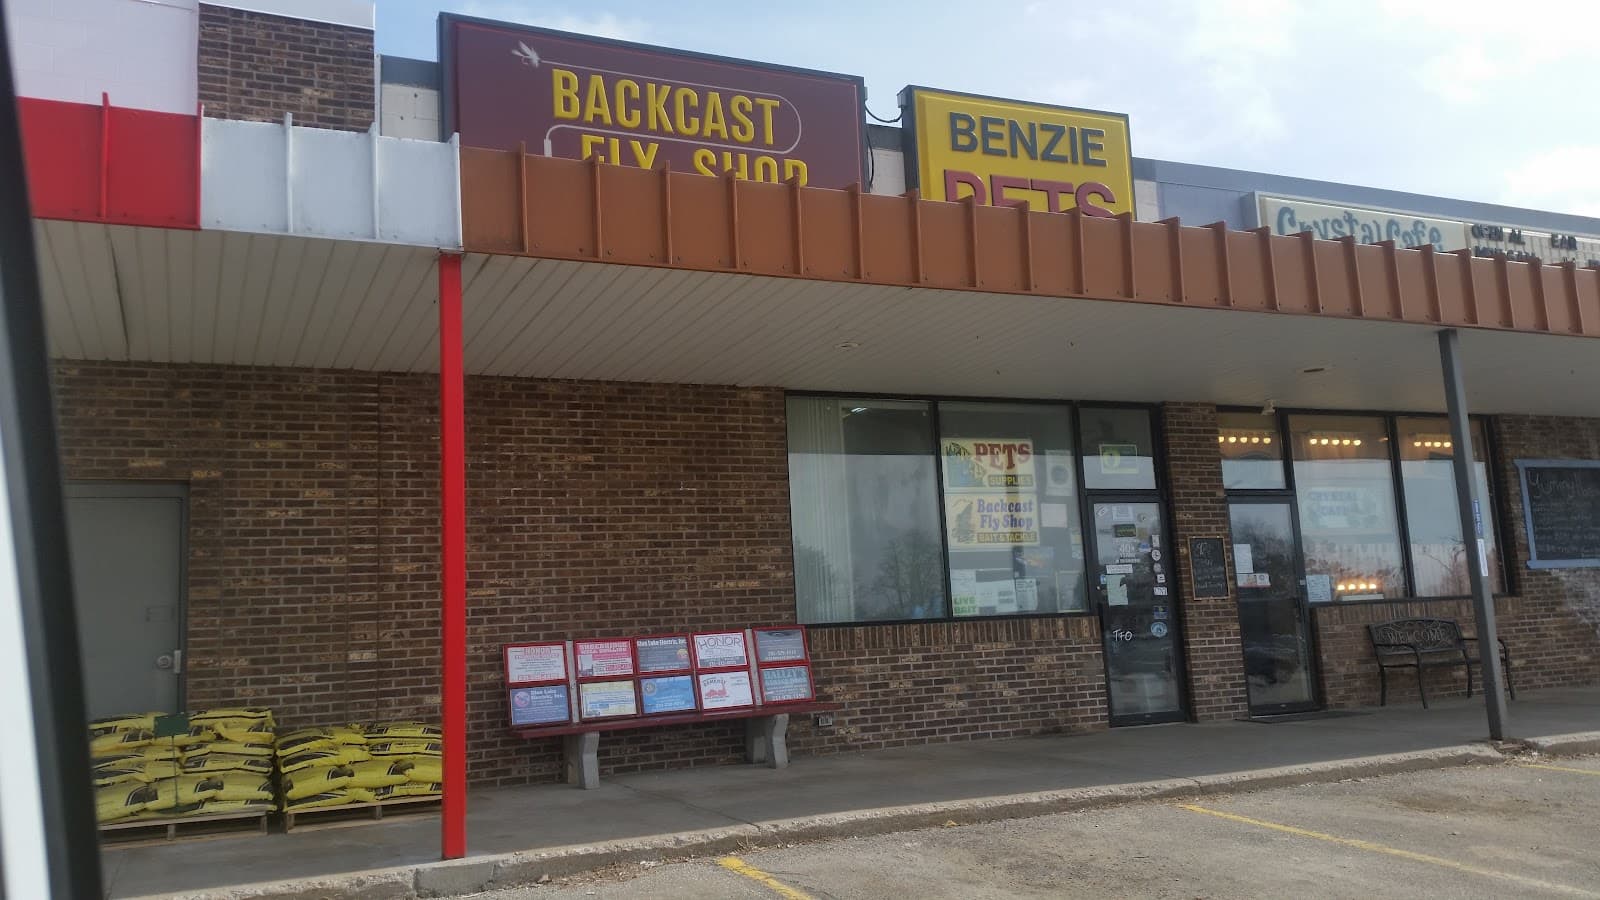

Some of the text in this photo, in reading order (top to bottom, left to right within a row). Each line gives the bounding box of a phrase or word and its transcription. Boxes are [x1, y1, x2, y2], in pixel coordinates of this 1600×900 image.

[552, 69, 780, 145] BACKCAST
[949, 111, 1108, 167] BENZIE
[974, 443, 1031, 470] PETS
[977, 499, 1032, 513] Backcast
[980, 514, 1032, 531] Fly Shop
